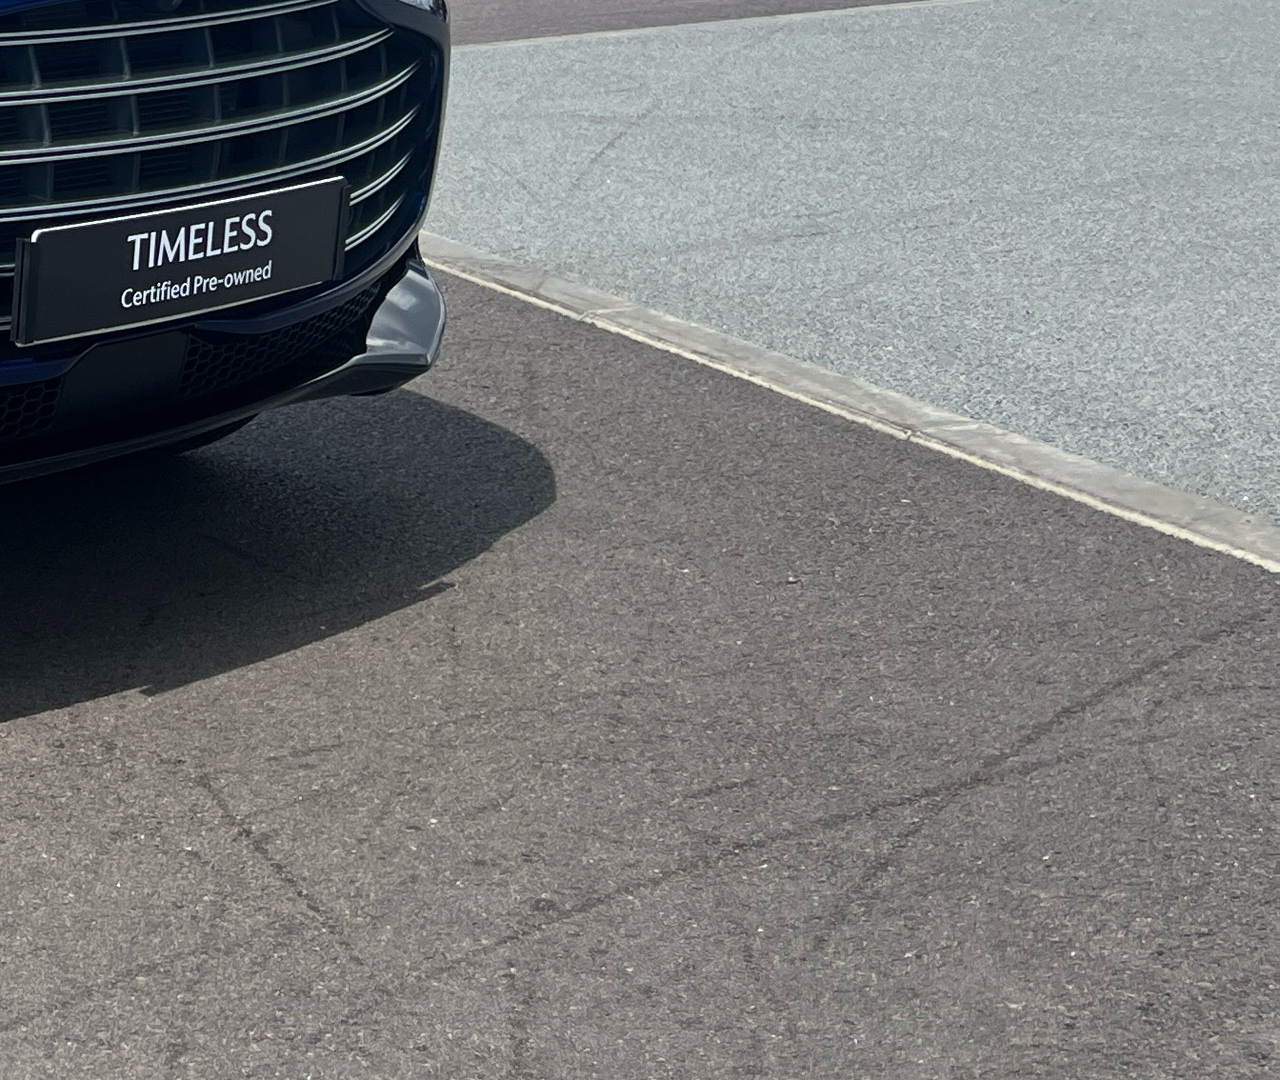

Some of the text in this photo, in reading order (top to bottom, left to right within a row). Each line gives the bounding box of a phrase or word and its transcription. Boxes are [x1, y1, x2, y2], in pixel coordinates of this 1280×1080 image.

[127, 209, 273, 271] TIMELESS
[121, 260, 273, 309] Certified Pre-owned
